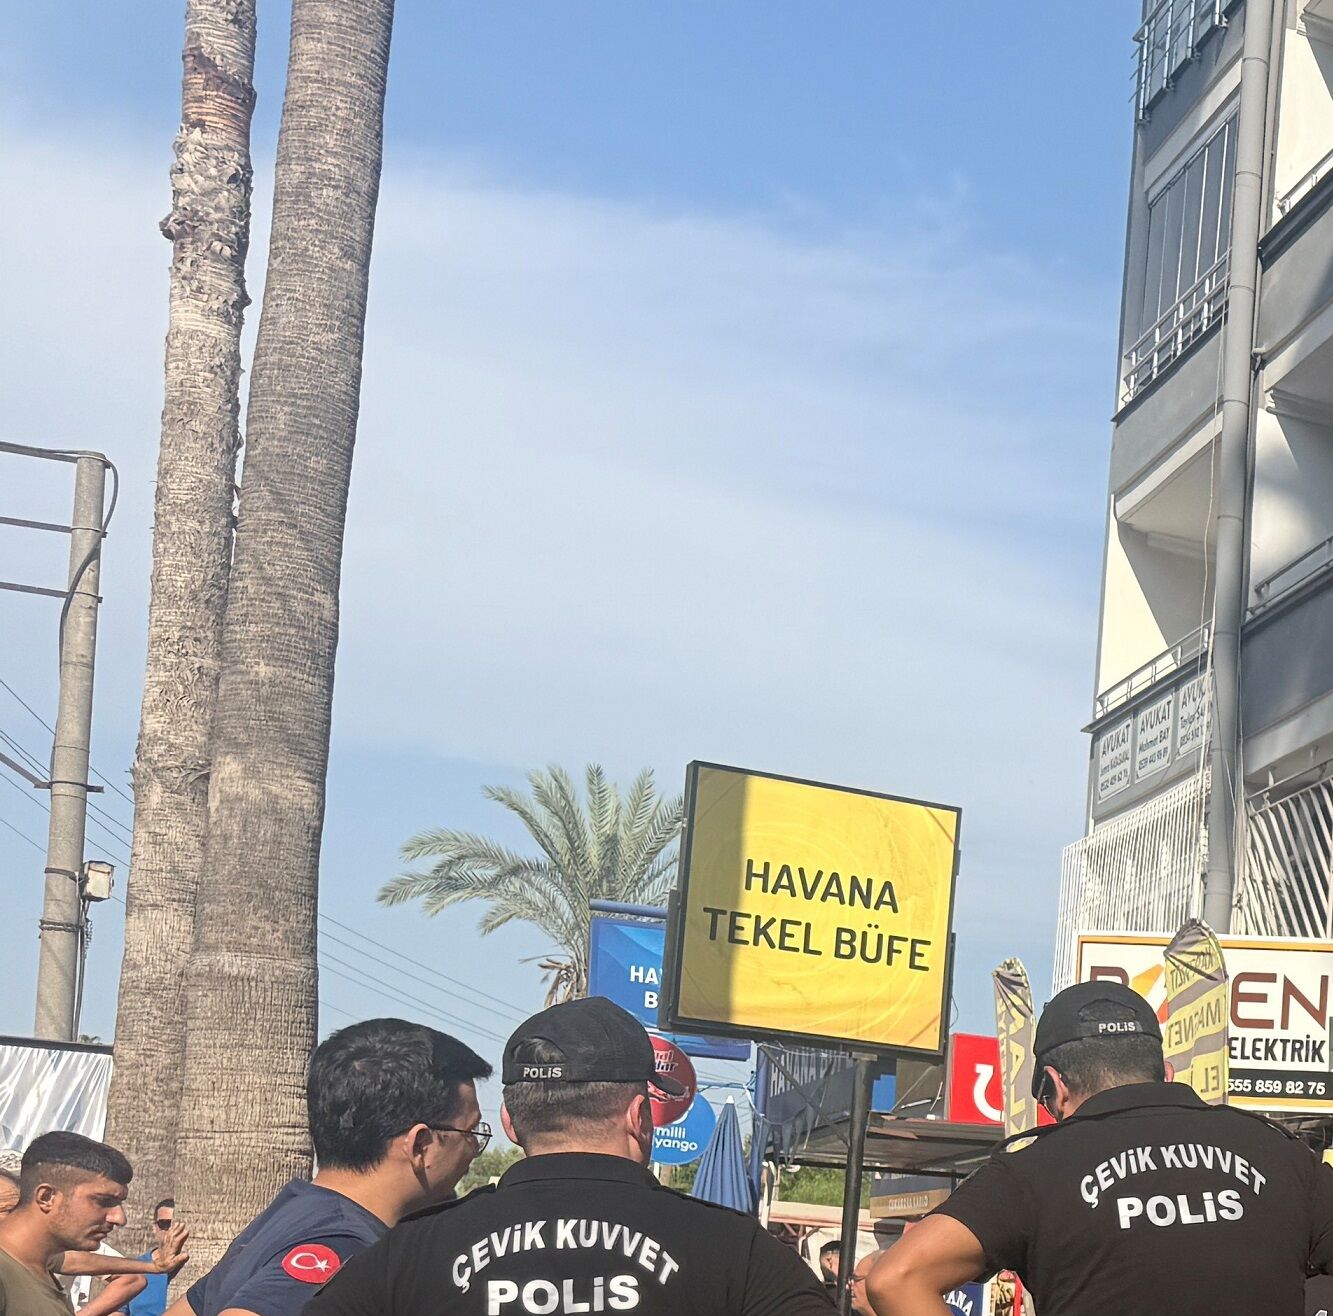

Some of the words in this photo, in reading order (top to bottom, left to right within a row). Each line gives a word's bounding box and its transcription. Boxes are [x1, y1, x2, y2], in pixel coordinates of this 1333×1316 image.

[744, 858, 899, 914] HAVANA
[702, 906, 823, 956] TEKEL
[833, 922, 932, 972] BÜFE
[1228, 1034, 1326, 1063] ELEKTRİK
[1255, 1079, 1283, 1094] 859
[1285, 1079, 1304, 1094] 82
[1307, 1081, 1326, 1095] 75
[1159, 1143, 1267, 1196] KUVVET
[555, 1218, 680, 1286] KUVVET
